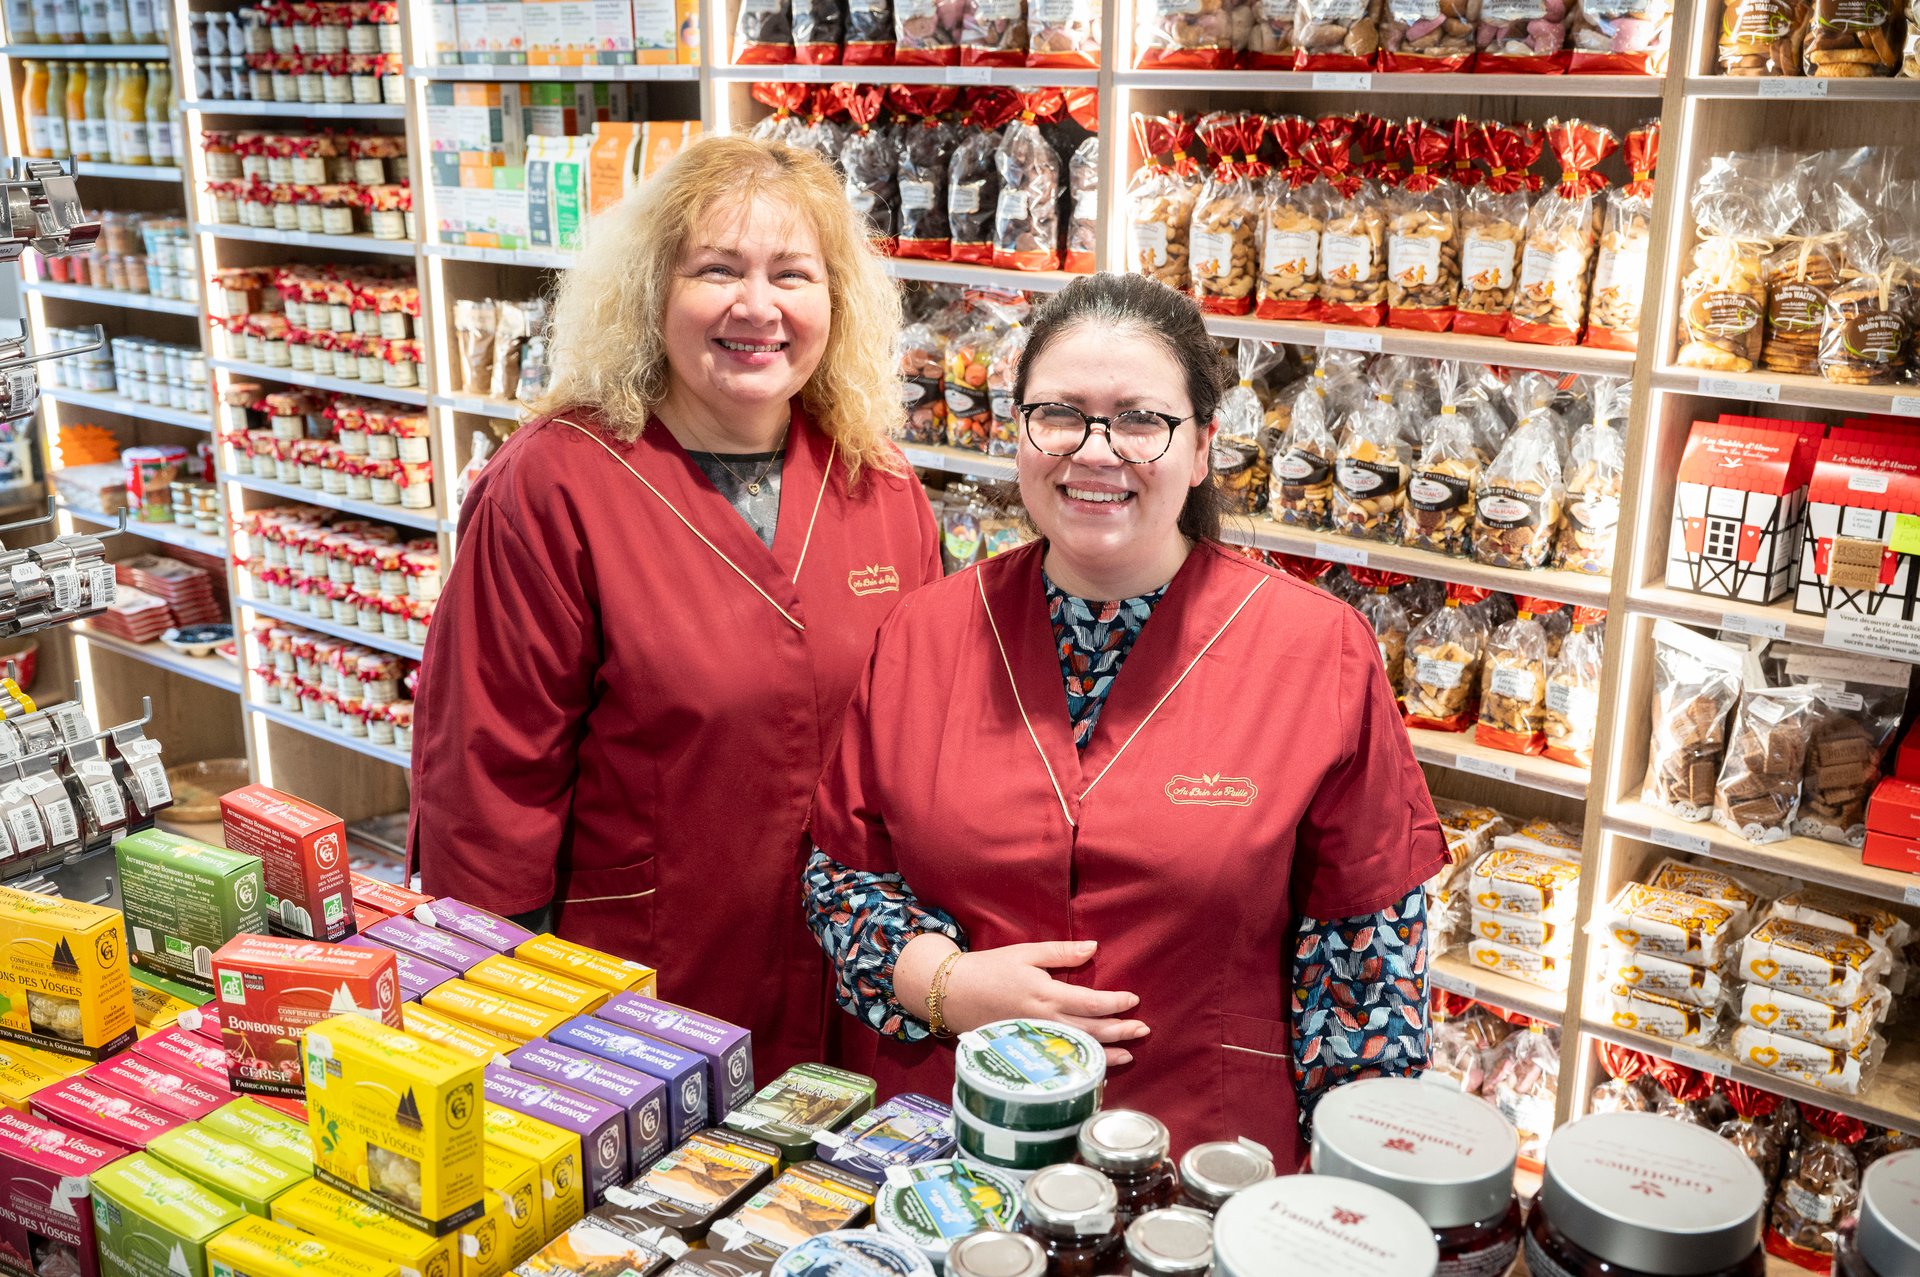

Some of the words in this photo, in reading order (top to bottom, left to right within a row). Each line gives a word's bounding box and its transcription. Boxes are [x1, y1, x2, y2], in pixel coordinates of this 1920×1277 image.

[1794, 291, 1818, 301] WALTER
[1880, 320, 1901, 332] WALTER
[1745, 442, 1779, 453] d'Alsace
[1832, 454, 1847, 463] Les
[1848, 456, 1878, 467] Sablés
[1879, 460, 1918, 472] d'Alsace
[1839, 613, 1858, 622] Venez
[1859, 616, 1891, 628] découvrir
[1892, 621, 1900, 629] de
[1901, 622, 1920, 632] délici
[1872, 627, 1909, 639] fabrication
[1879, 636, 1918, 648] Expressions
[1843, 638, 1864, 647] sucrés
[1874, 642, 1890, 651] salés
[1907, 648, 1920, 656] alle
[1173, 787, 1189, 796] Au
[1212, 788, 1222, 797] de
[1223, 787, 1248, 797] Paille
[326, 900, 341, 918] AB
[327, 930, 347, 941] VOSGES
[327, 946, 374, 961] VOSGES
[18, 975, 38, 988] DES
[40, 978, 83, 997] VOSGES
[222, 979, 241, 996] AB
[277, 1007, 321, 1019] CONFISERIE
[613, 1004, 652, 1024] VOSGES
[0, 1018, 28, 1032] BELLE
[228, 1016, 286, 1036] BONBONS
[671, 1022, 722, 1046] BONBONS
[568, 1028, 607, 1048] VOSGES
[522, 1052, 563, 1072] VOSGES
[628, 1047, 677, 1071] BONBONS
[239, 1066, 292, 1084] CERISE
[181, 1082, 219, 1103] VOSGES
[235, 1080, 280, 1093] FABRICATION
[583, 1073, 635, 1097] BONBONS
[129, 1106, 169, 1127] VOSGES
[539, 1100, 593, 1124] BONBONS
[64, 1137, 106, 1158] VOSGES
[359, 1124, 378, 1141] DES
[381, 1131, 425, 1160] VOSGES
[19, 1215, 38, 1231] DES
[39, 1222, 82, 1246] VOSGES
